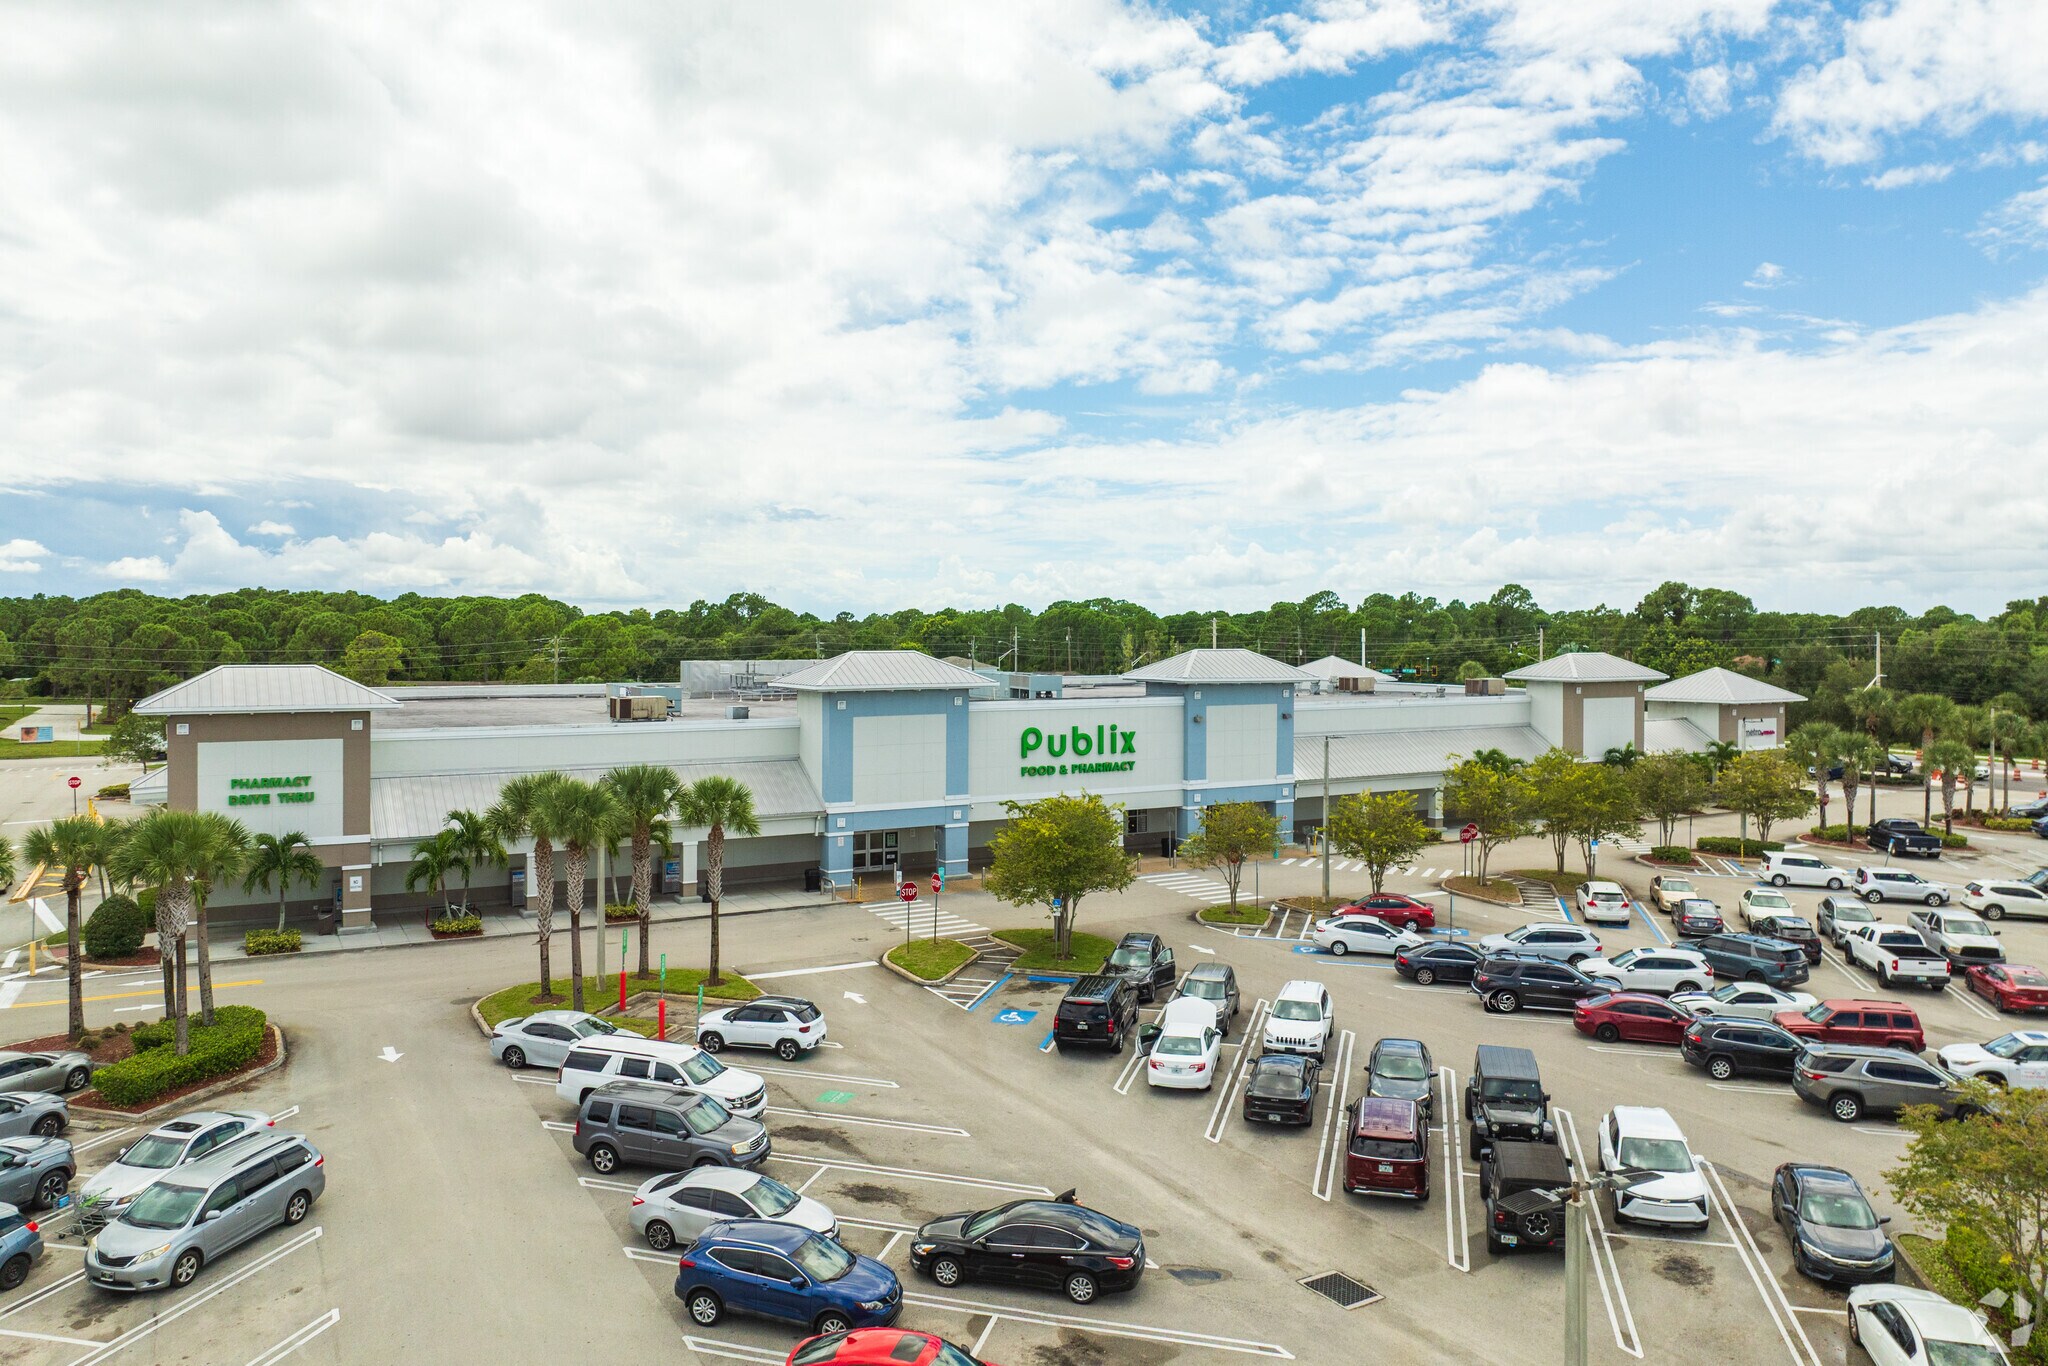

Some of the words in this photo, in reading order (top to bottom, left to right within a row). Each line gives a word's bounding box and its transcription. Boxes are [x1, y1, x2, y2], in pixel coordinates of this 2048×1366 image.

[1021, 724, 1136, 758] Publix
[1021, 765, 1056, 777] FOOD
[1059, 764, 1068, 775] &
[1071, 761, 1136, 774] PHARMACY
[231, 776, 312, 789] PHARMACY
[228, 793, 270, 806] DRIVE
[277, 791, 314, 804] THRU
[1461, 832, 1471, 840] STOP
[931, 879, 942, 887] STOP
[901, 888, 917, 897] STOP
